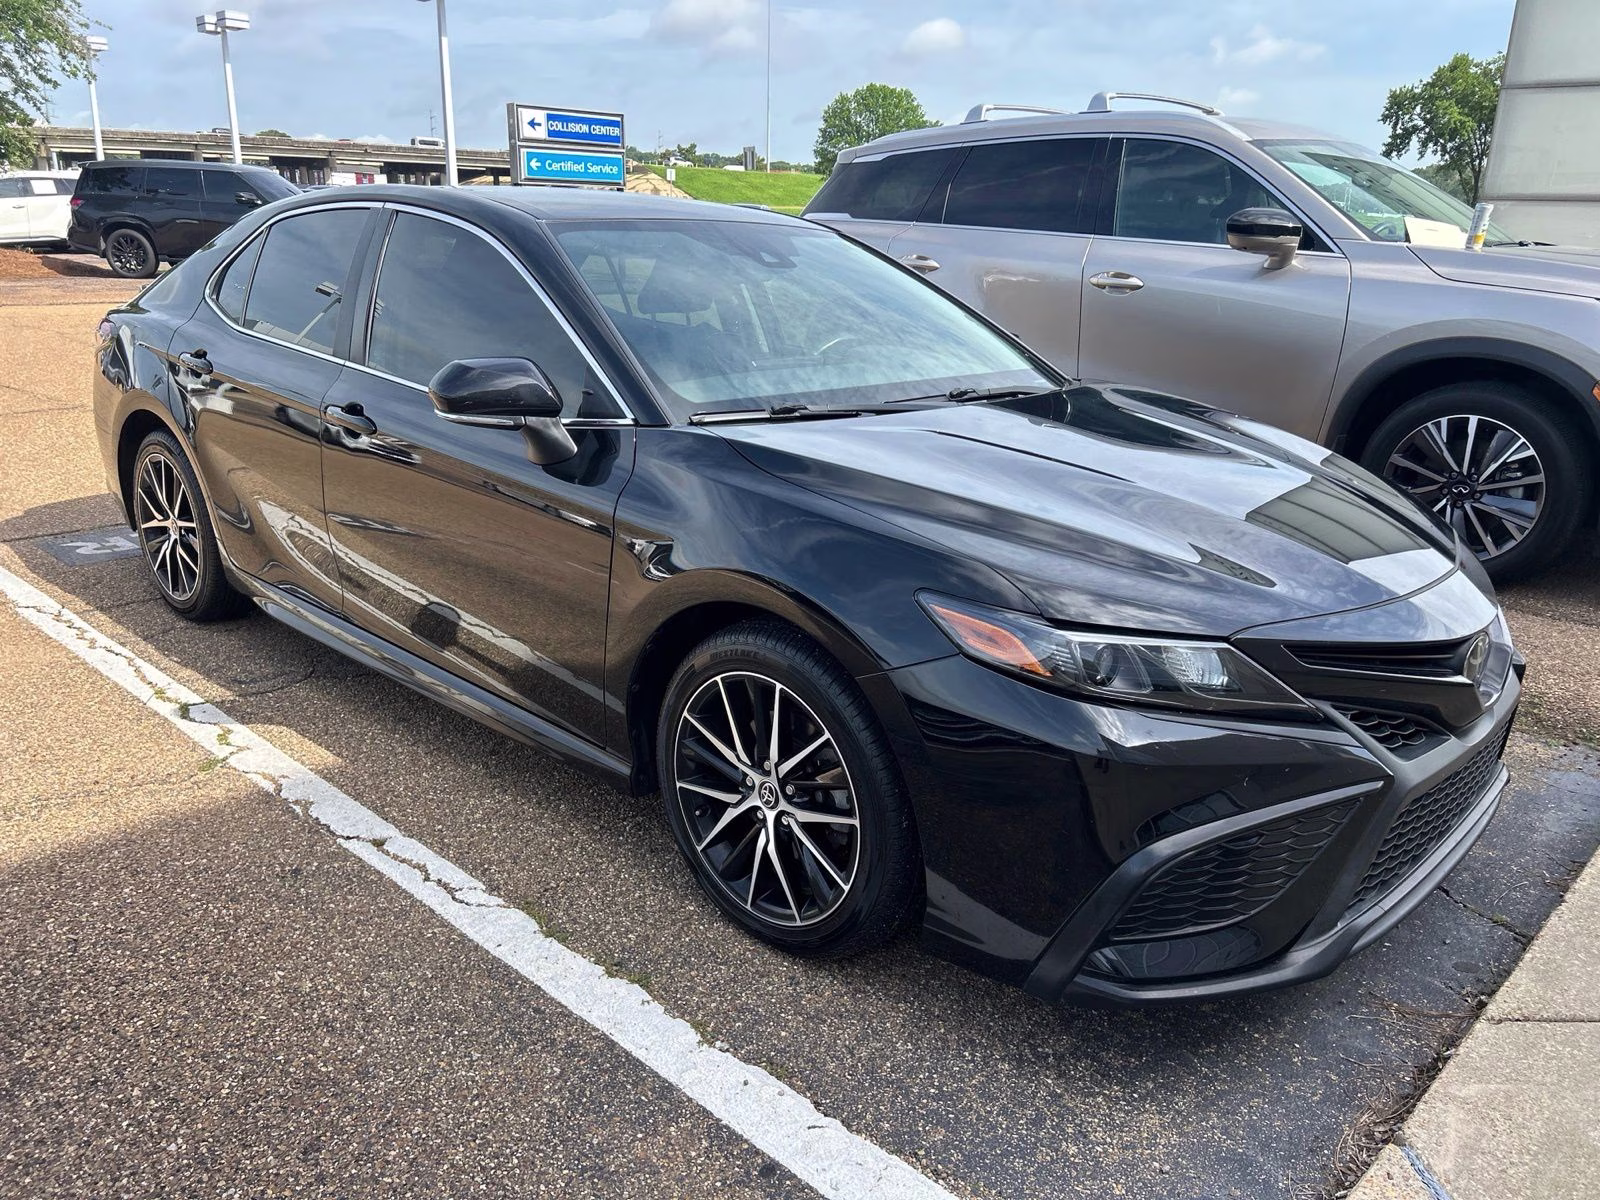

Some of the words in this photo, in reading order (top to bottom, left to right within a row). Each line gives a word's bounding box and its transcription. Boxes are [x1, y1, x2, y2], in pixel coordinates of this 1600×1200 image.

[548, 121, 589, 133] COLLISION
[591, 125, 620, 136] CENTER
[545, 160, 584, 173] Certified
[587, 163, 618, 174] Service
